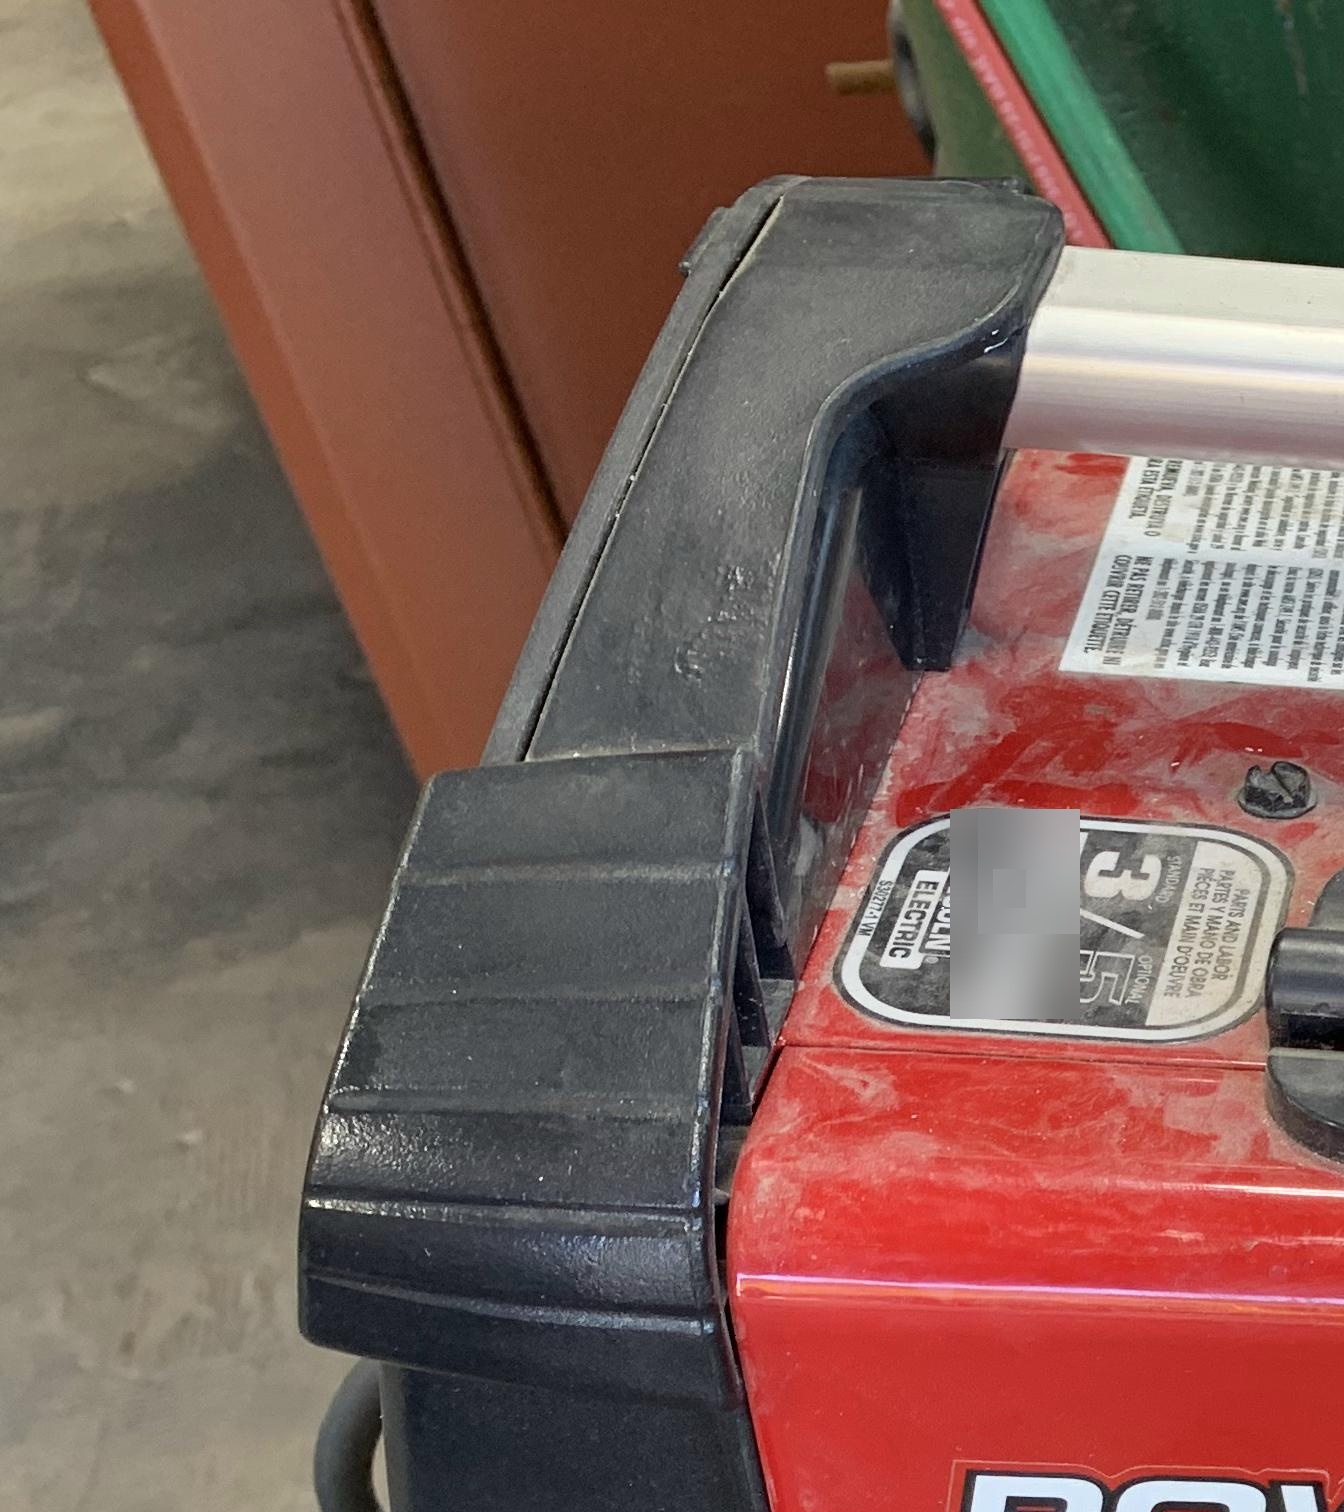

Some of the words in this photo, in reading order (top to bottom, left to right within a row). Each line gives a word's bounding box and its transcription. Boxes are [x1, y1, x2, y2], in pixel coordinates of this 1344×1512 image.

[1104, 554, 1133, 588] COUVRIR
[1127, 567, 1148, 582] PAS
[1097, 590, 1121, 611] CETTE
[1153, 855, 1182, 903] STANDARD
[1211, 869, 1235, 903] PARTES
[1186, 902, 1205, 913] ET
[1227, 888, 1250, 918] PARTS
[857, 921, 876, 936] VM
[887, 880, 939, 958] ELECTRIC
[1178, 915, 1201, 942] MAIN
[1197, 915, 1222, 949] MANO
[1220, 920, 1241, 943] AND
[1162, 945, 1193, 997] D'OEUVRE
[1193, 951, 1213, 965] DE
[1209, 945, 1235, 980] LABOR
[1125, 954, 1154, 1004] OPTIONAL
[1184, 967, 1208, 998] OBRA
